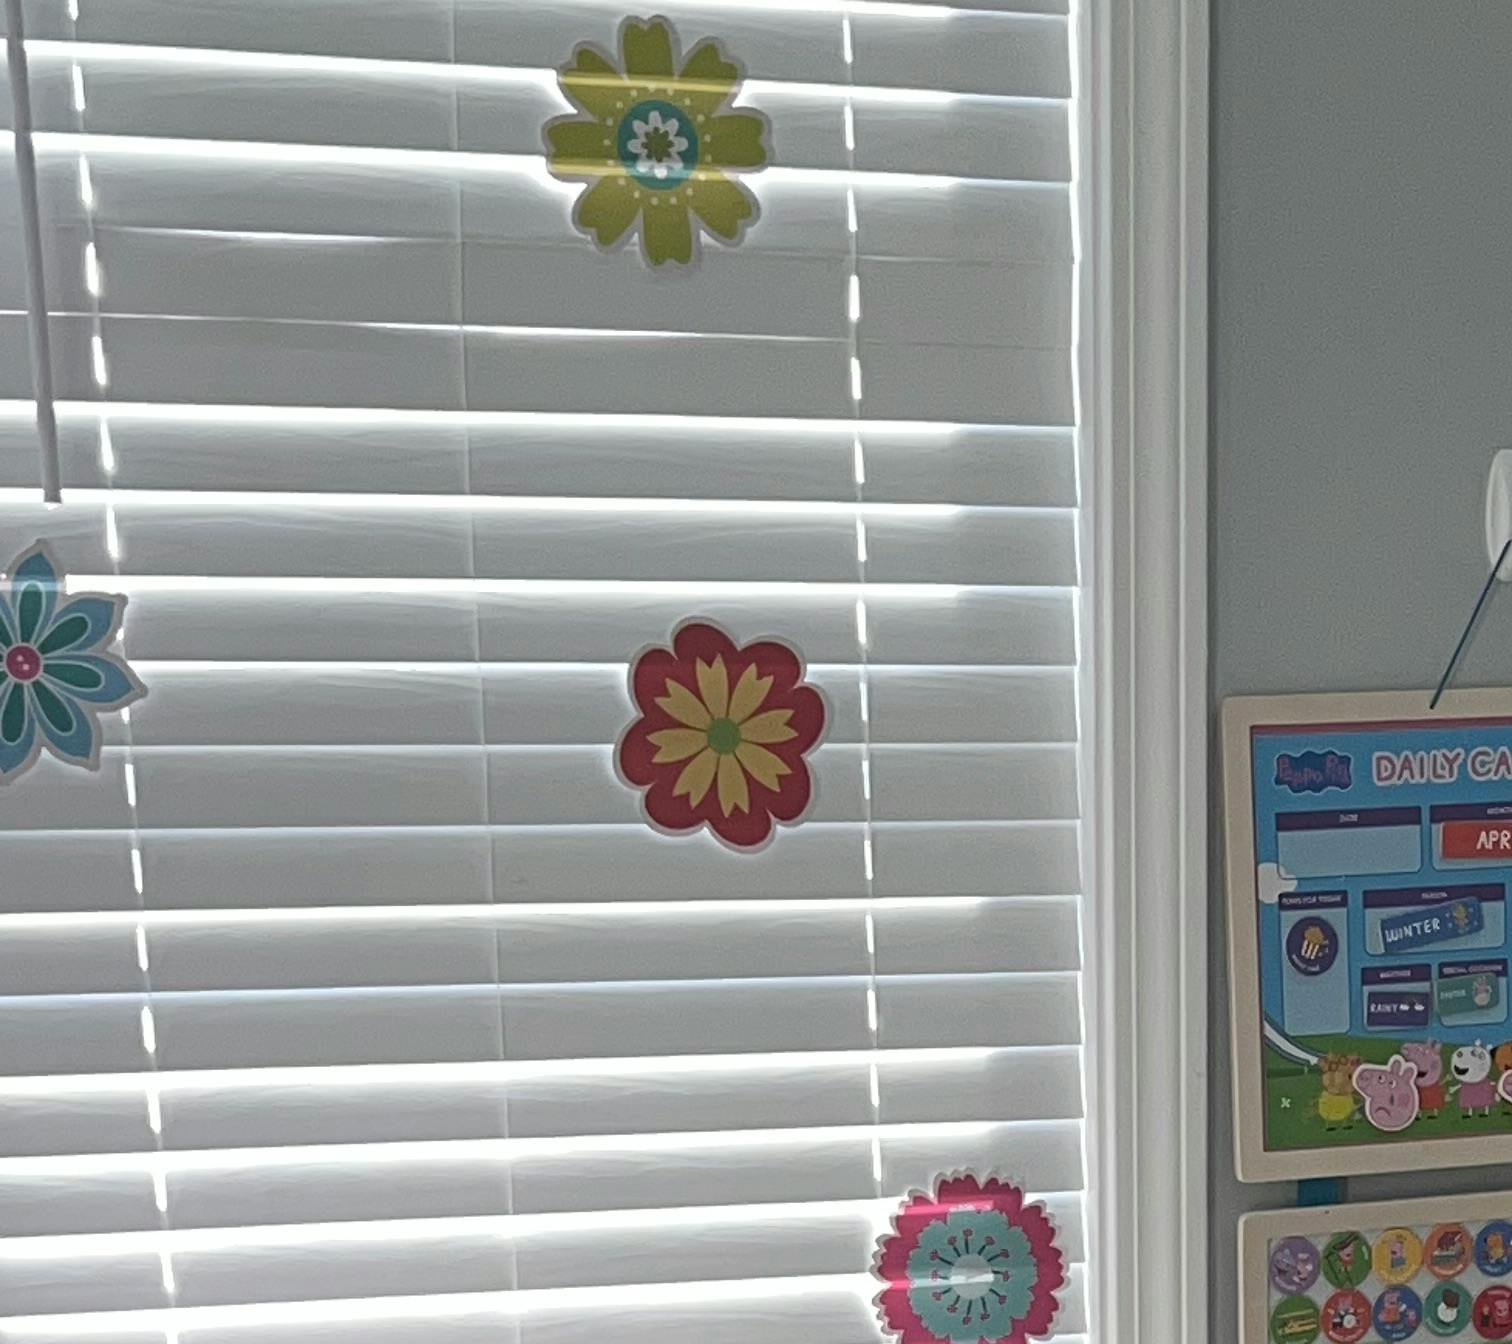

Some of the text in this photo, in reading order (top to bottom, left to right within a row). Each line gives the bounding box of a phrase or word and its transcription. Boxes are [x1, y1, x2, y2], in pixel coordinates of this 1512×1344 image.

[1373, 750, 1463, 784] DAILY
[1384, 917, 1441, 943] WINTER
[1370, 1002, 1398, 1013] RAINY
